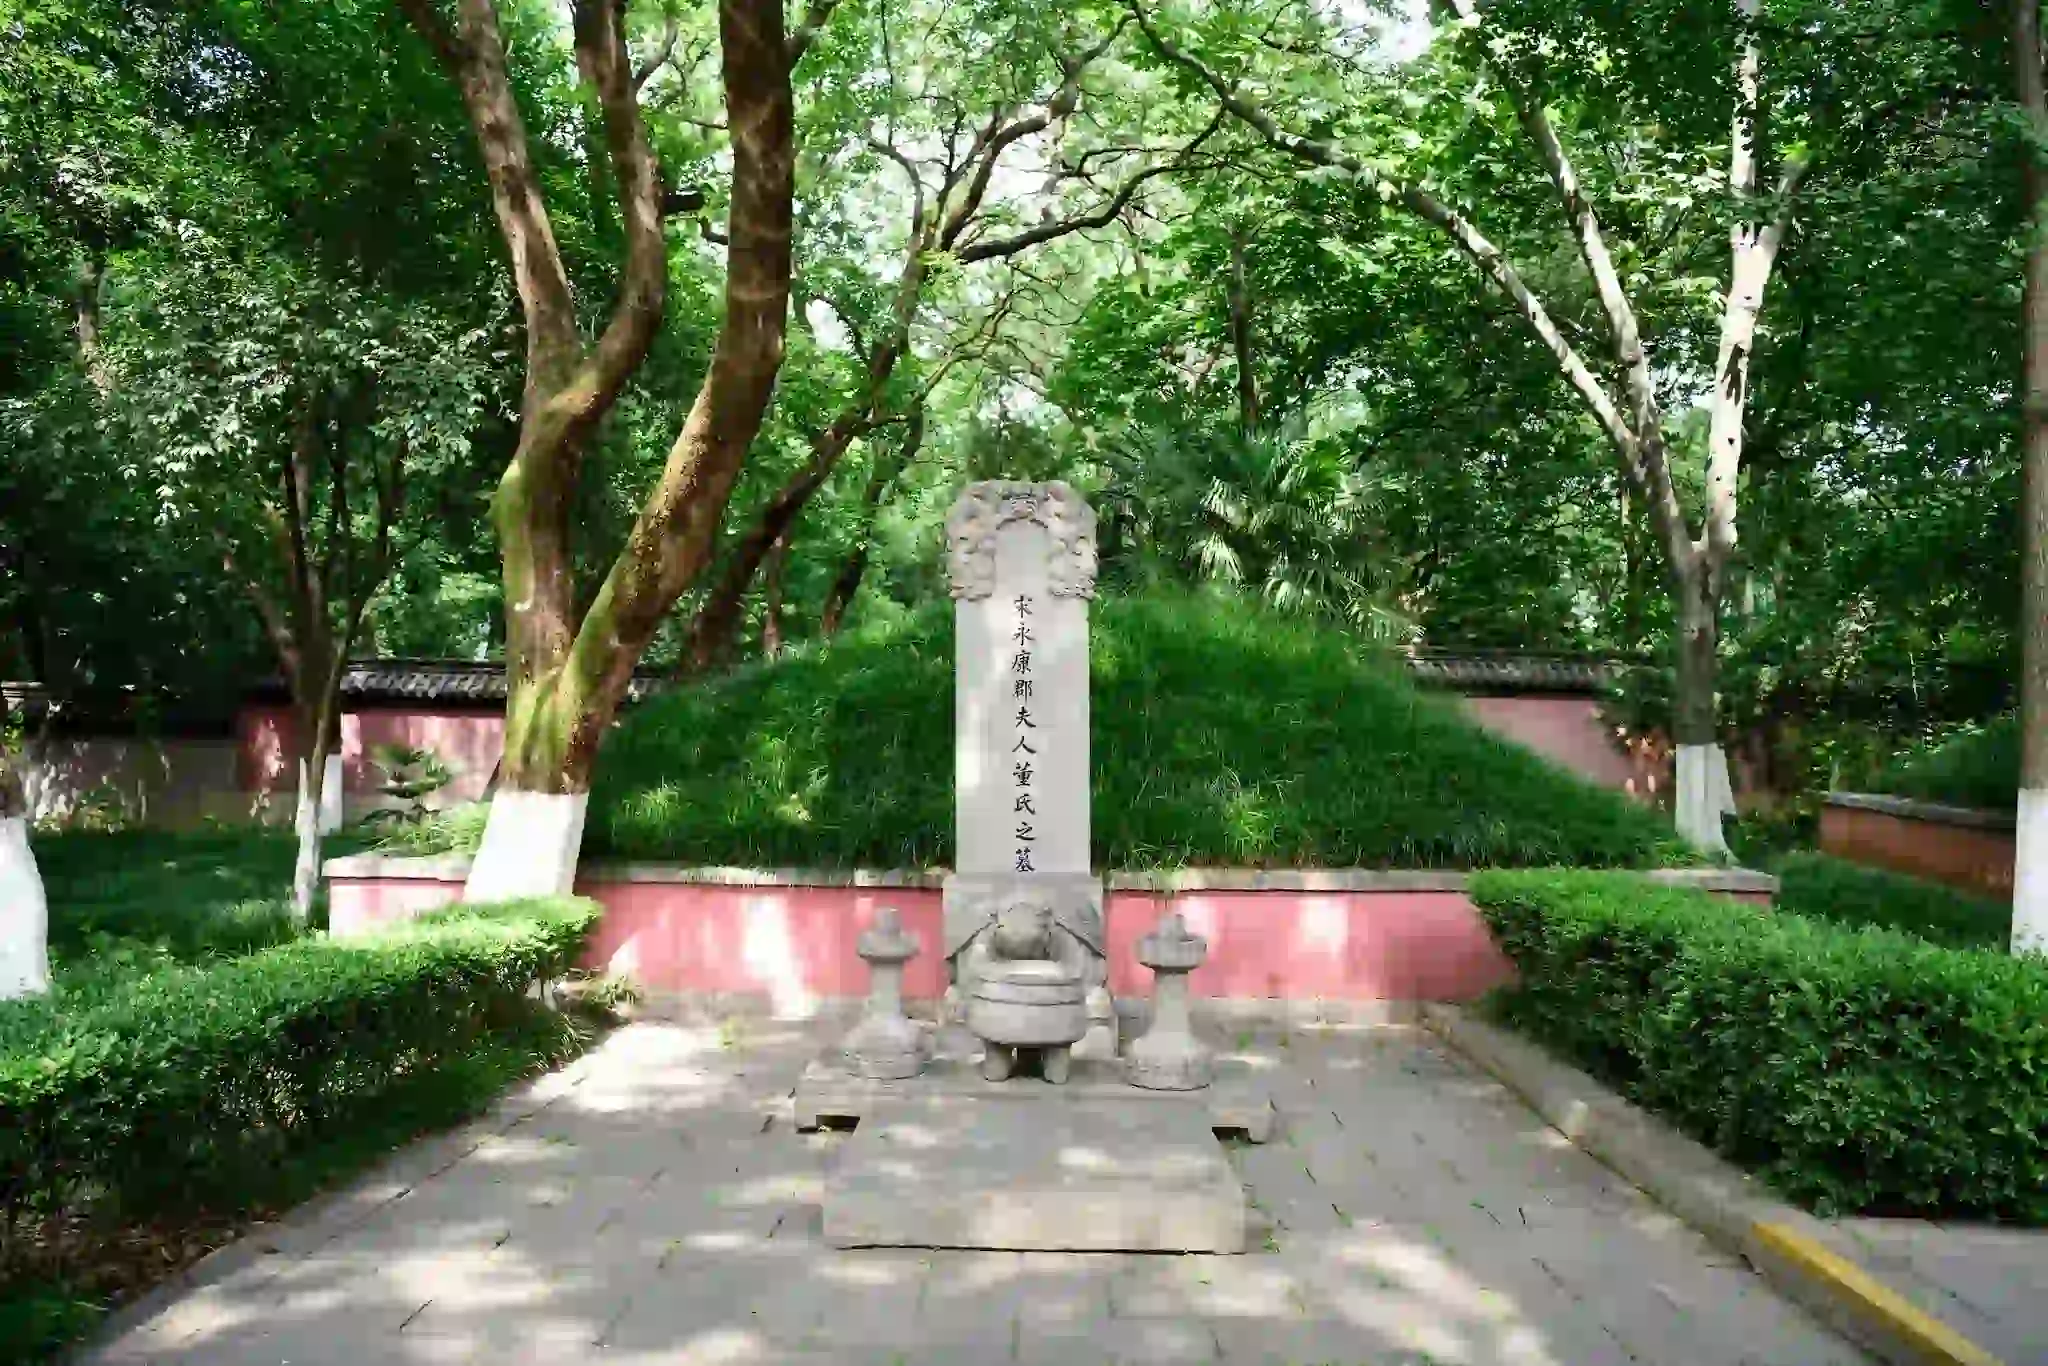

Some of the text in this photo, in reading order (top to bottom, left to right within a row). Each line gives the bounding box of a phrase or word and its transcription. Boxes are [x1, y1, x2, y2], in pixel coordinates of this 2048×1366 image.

[1011, 595, 1037, 873] 宋永康郡夫人董氏之墓
